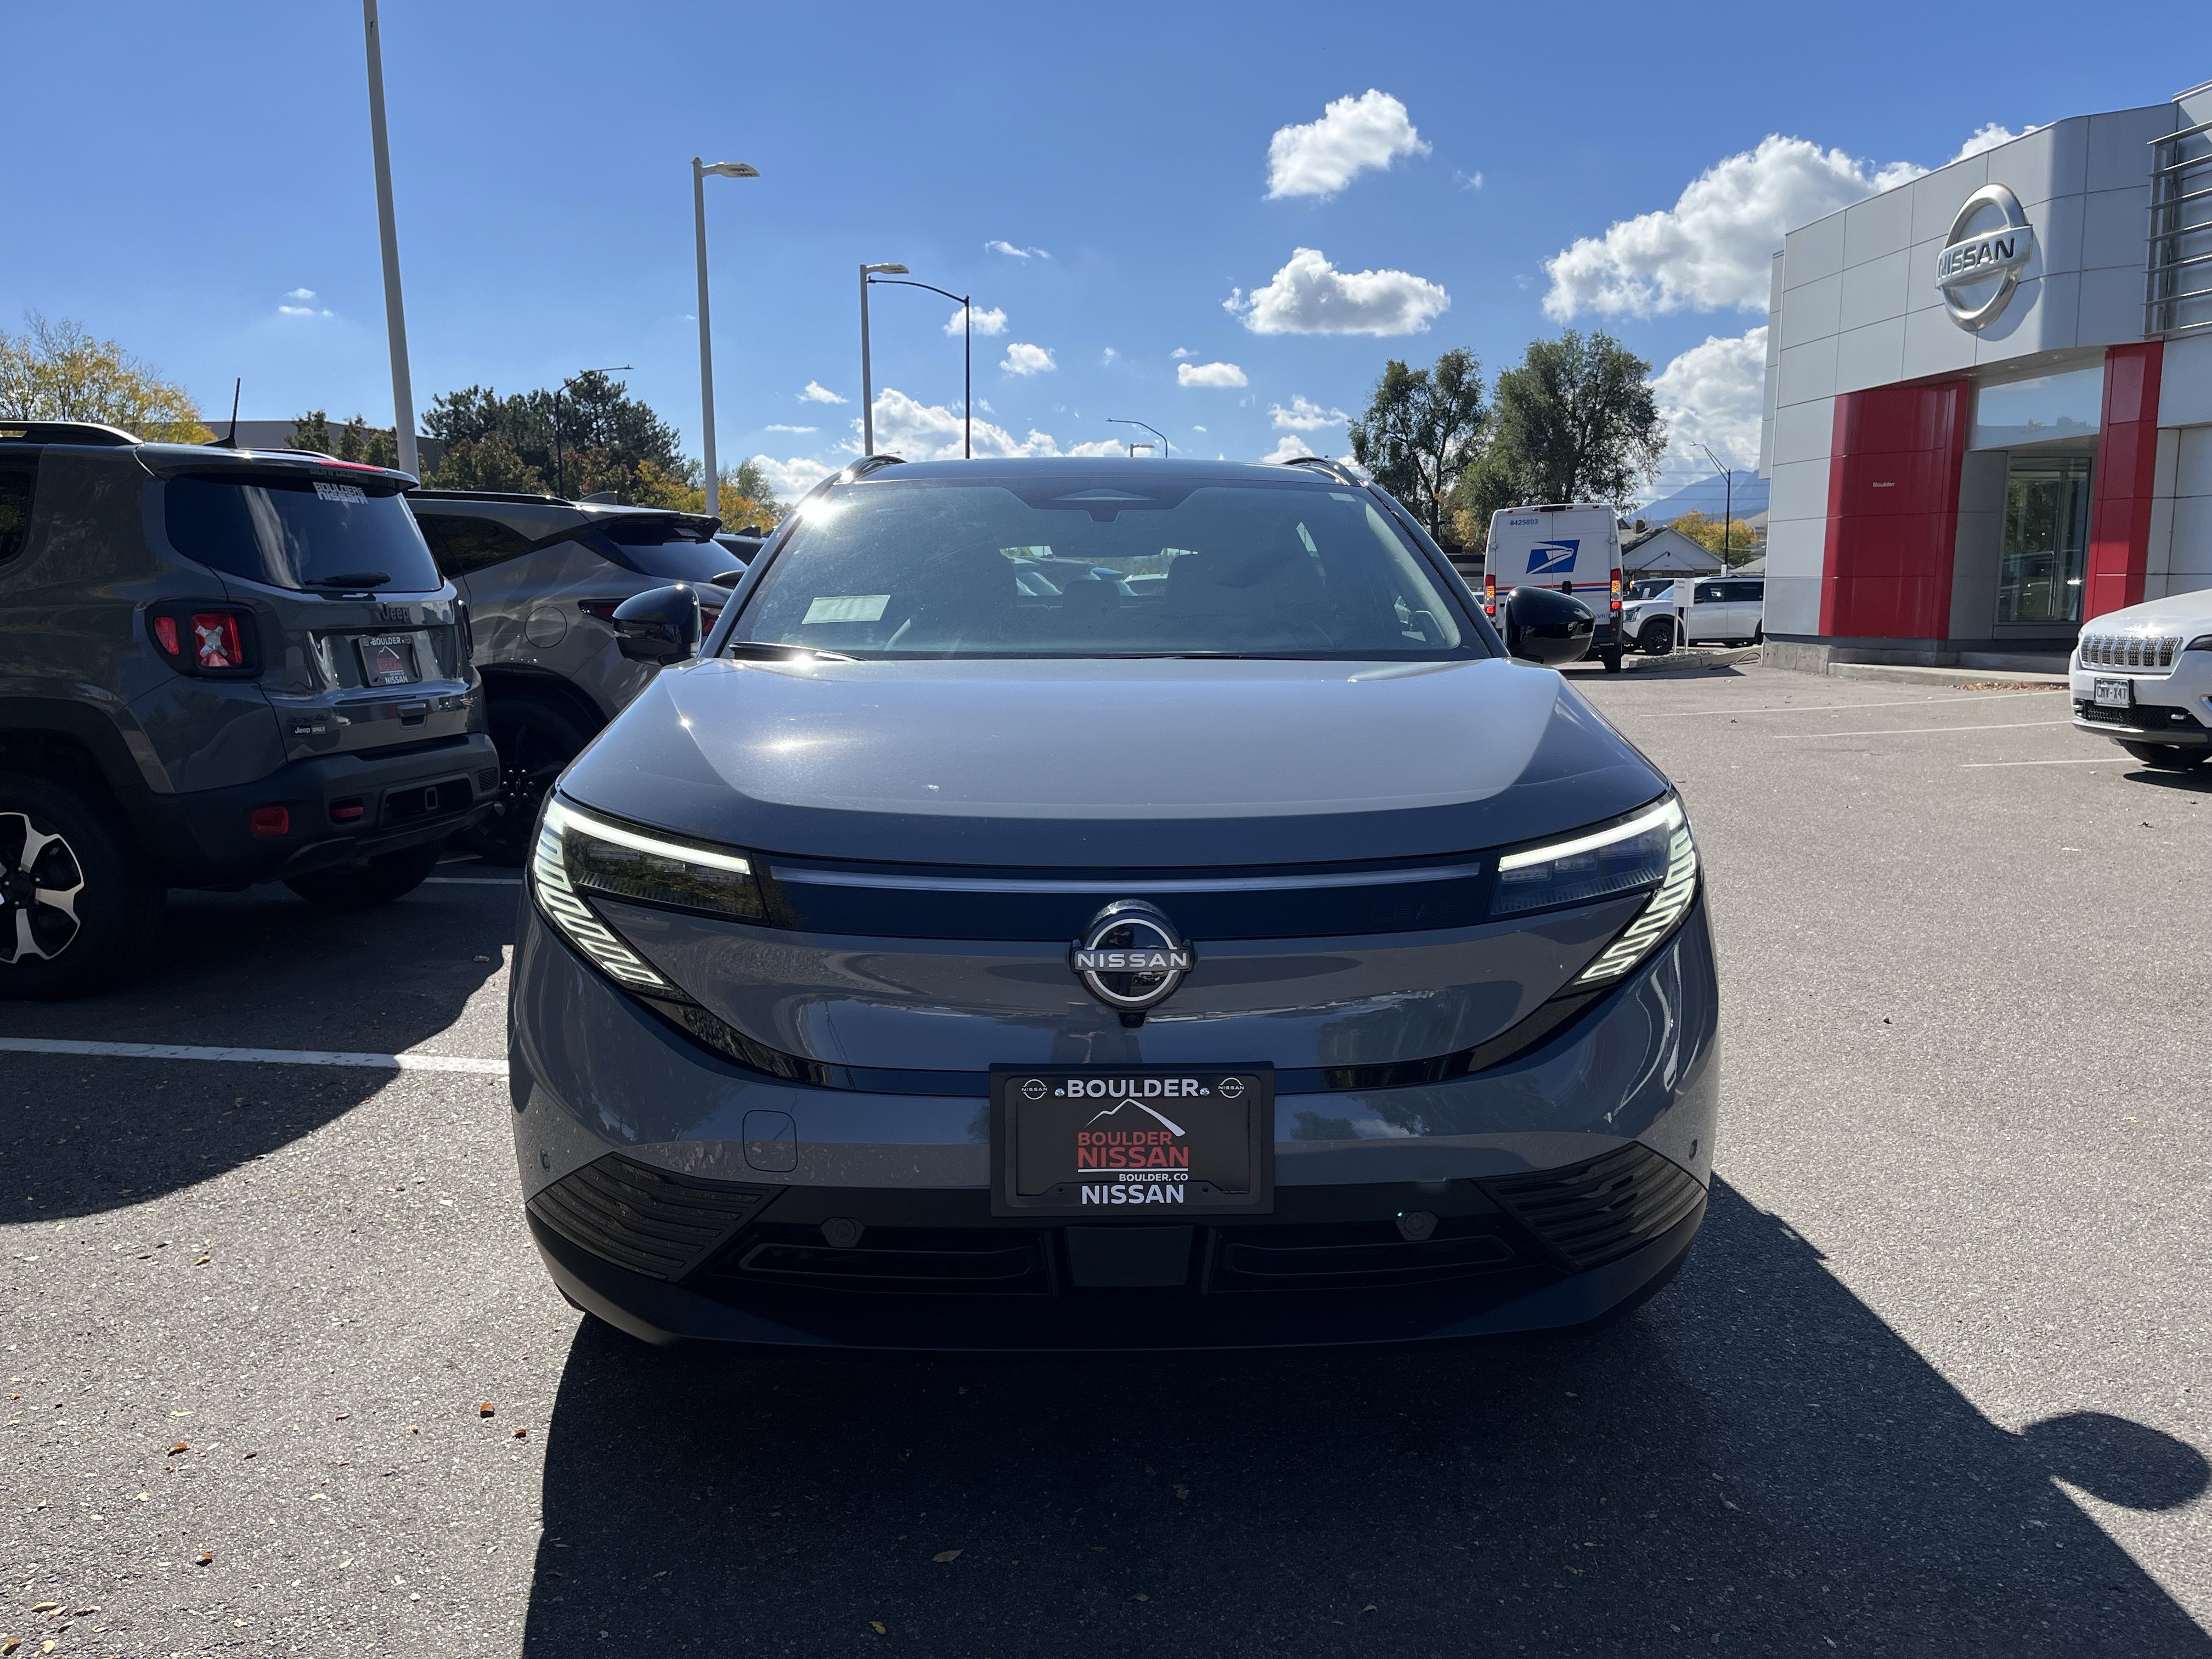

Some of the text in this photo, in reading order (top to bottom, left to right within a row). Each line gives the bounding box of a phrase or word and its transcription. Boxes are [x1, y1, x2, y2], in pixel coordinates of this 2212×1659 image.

[1938, 235, 2015, 279] NISSAN
[382, 604, 410, 622] Jeep
[371, 636, 402, 646] BOULDER
[385, 675, 409, 685] NISSAN
[1372, 903, 1458, 922] LEAF
[1077, 952, 1187, 968] NISSAN
[1067, 1079, 1199, 1098] BOULDER
[1077, 1131, 1172, 1146] BOULDER
[1077, 1146, 1189, 1168] NISSAN
[1119, 1173, 1188, 1182] BOULDER, CO
[1081, 1184, 1184, 1204] NISSAN
